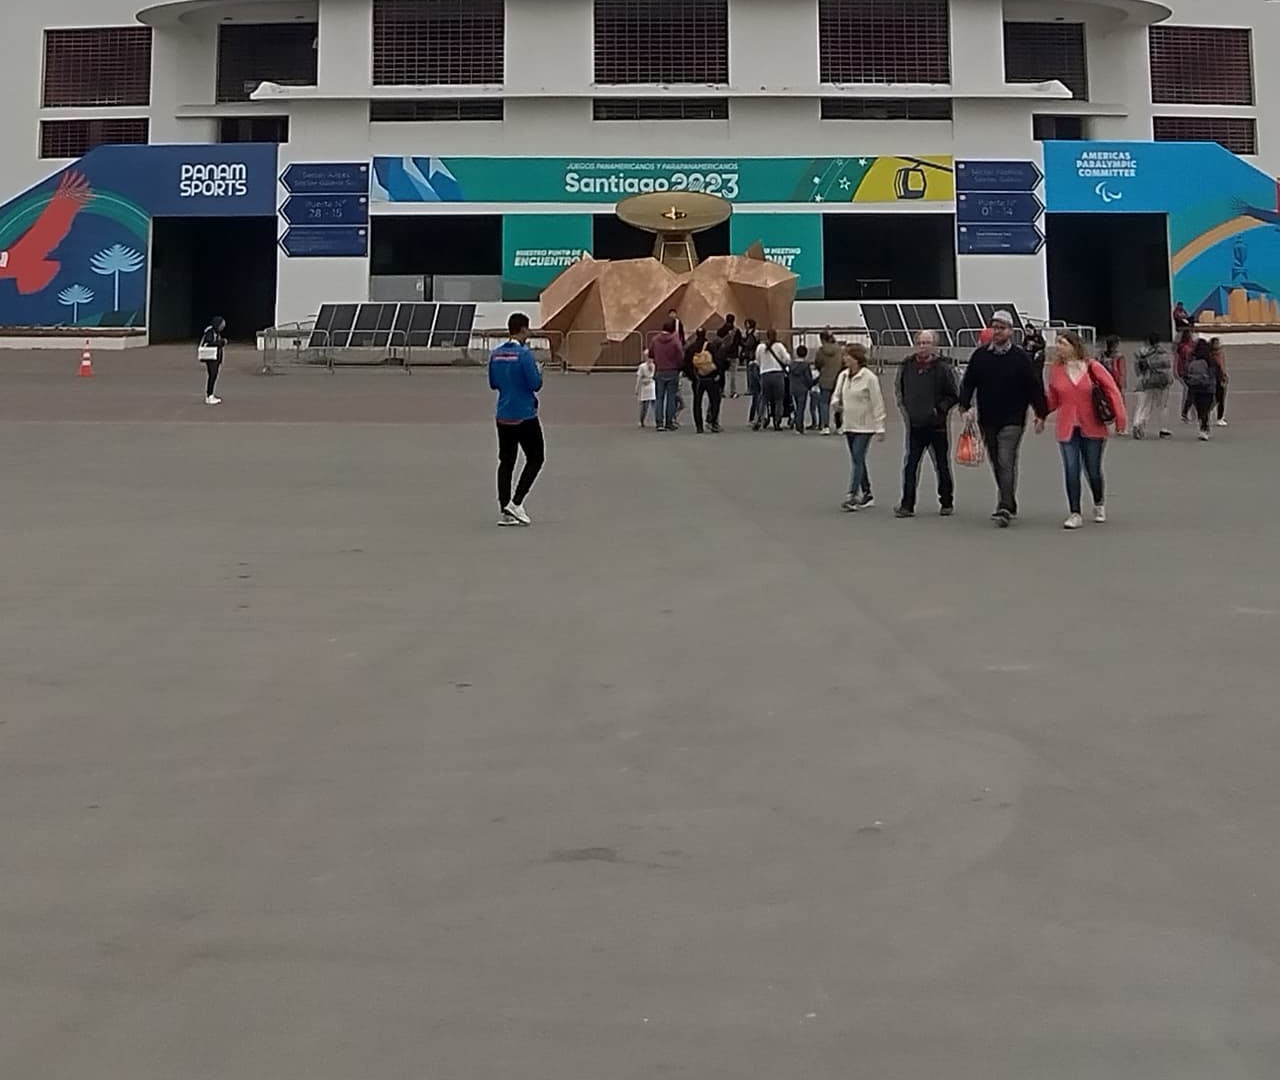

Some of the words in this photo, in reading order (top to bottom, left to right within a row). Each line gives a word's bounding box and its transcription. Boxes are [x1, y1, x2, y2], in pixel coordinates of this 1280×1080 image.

[1081, 151, 1131, 160] AMERICAS
[1076, 160, 1137, 168] PARALYMPIC
[181, 164, 246, 180] PANAM
[1078, 169, 1136, 177] COMMITTEE
[179, 180, 247, 196] SPORTS
[564, 172, 669, 194] Santiago
[671, 173, 739, 199] 2023
[514, 257, 581, 267] ENCUENTRO
